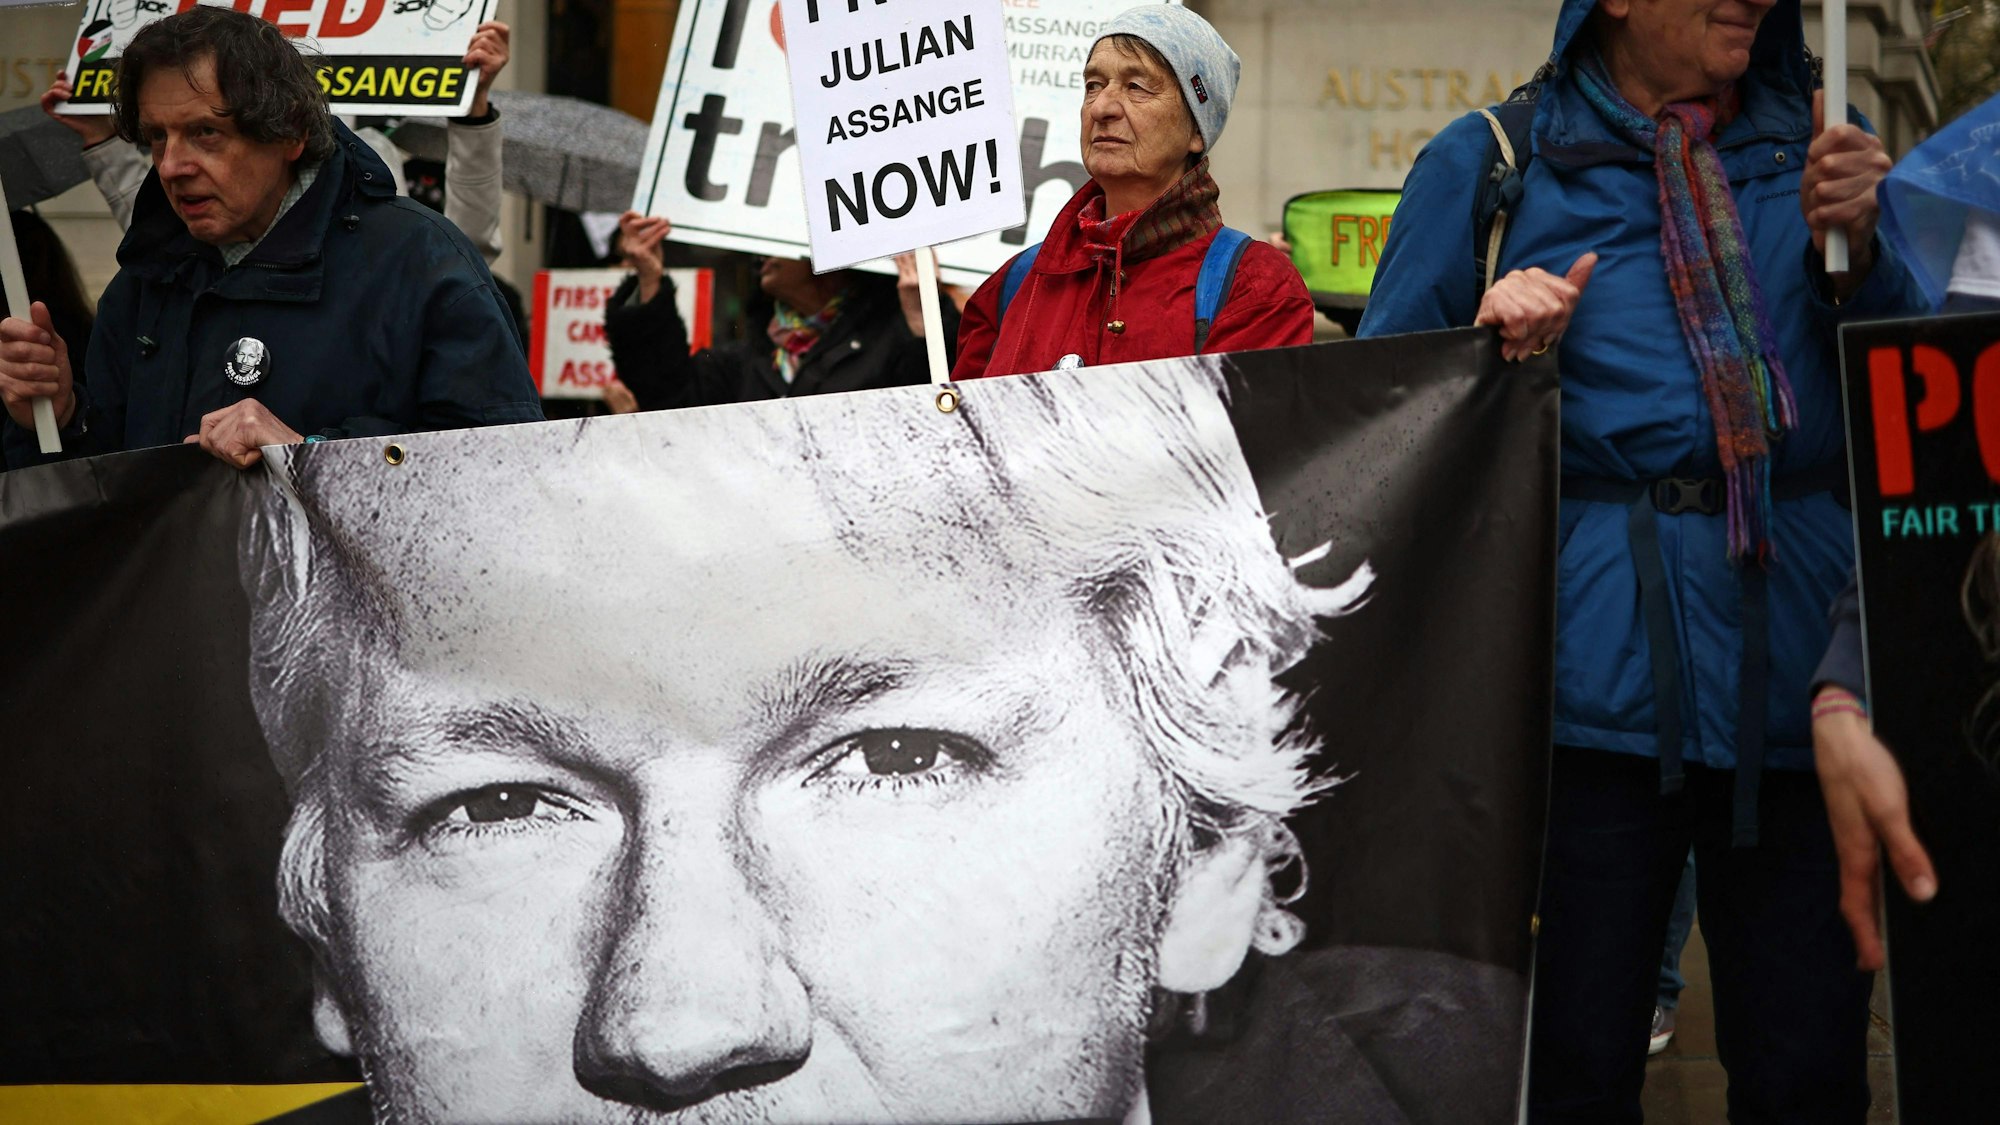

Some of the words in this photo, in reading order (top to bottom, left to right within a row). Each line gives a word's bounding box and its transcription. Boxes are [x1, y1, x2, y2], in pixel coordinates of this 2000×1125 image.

[820, 15, 974, 89] JULIAN
[315, 66, 463, 98] SSANGE
[1020, 68, 1082, 89] HALE
[826, 79, 985, 145] ASSANGE
[825, 138, 1002, 232] NOW!
[233, 369, 262, 383] ASSANGE
[558, 360, 618, 387] ASS
[1881, 504, 1960, 539] FAIR
